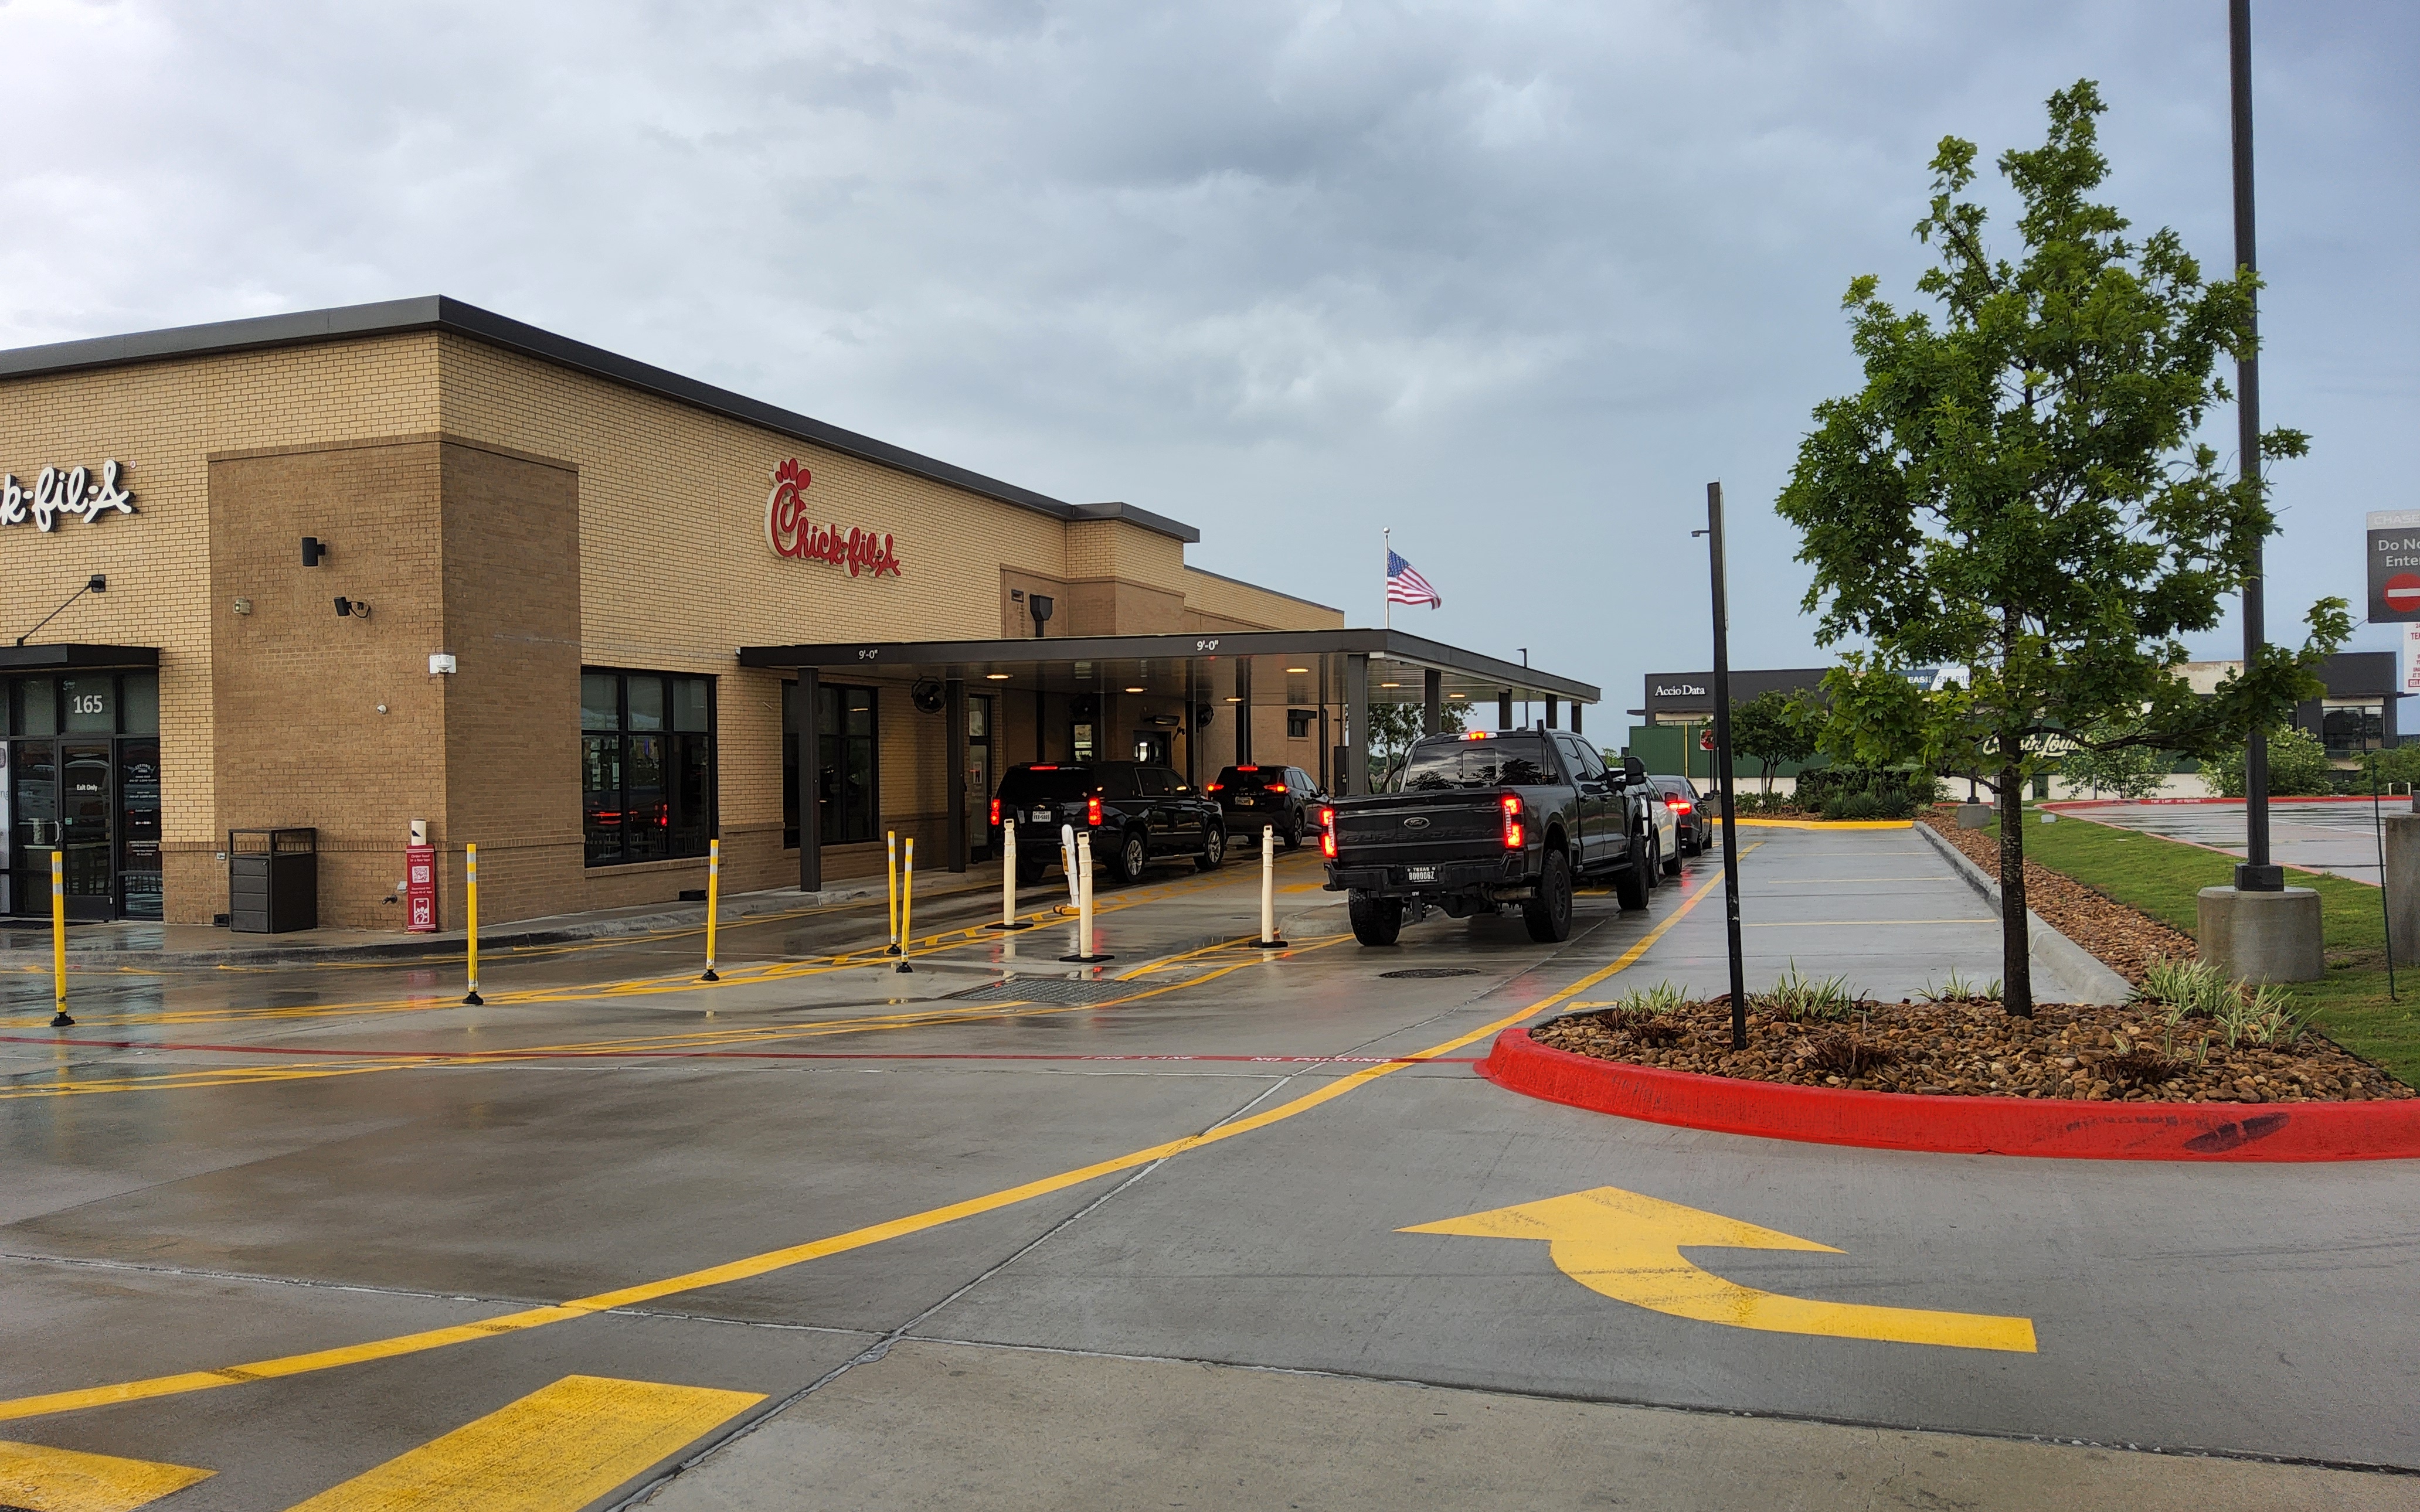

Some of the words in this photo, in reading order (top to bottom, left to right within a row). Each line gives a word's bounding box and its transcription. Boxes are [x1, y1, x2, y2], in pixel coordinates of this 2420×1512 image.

[2374, 515, 2420, 525] CHASE
[771, 482, 901, 577] Chick-fil-A
[2378, 540, 2399, 551] Do
[2386, 555, 2420, 567] Ente
[1197, 639, 1219, 651] 9'-0"
[1654, 685, 1681, 696] Accio
[1682, 685, 1705, 695] Data
[73, 695, 103, 713] 165
